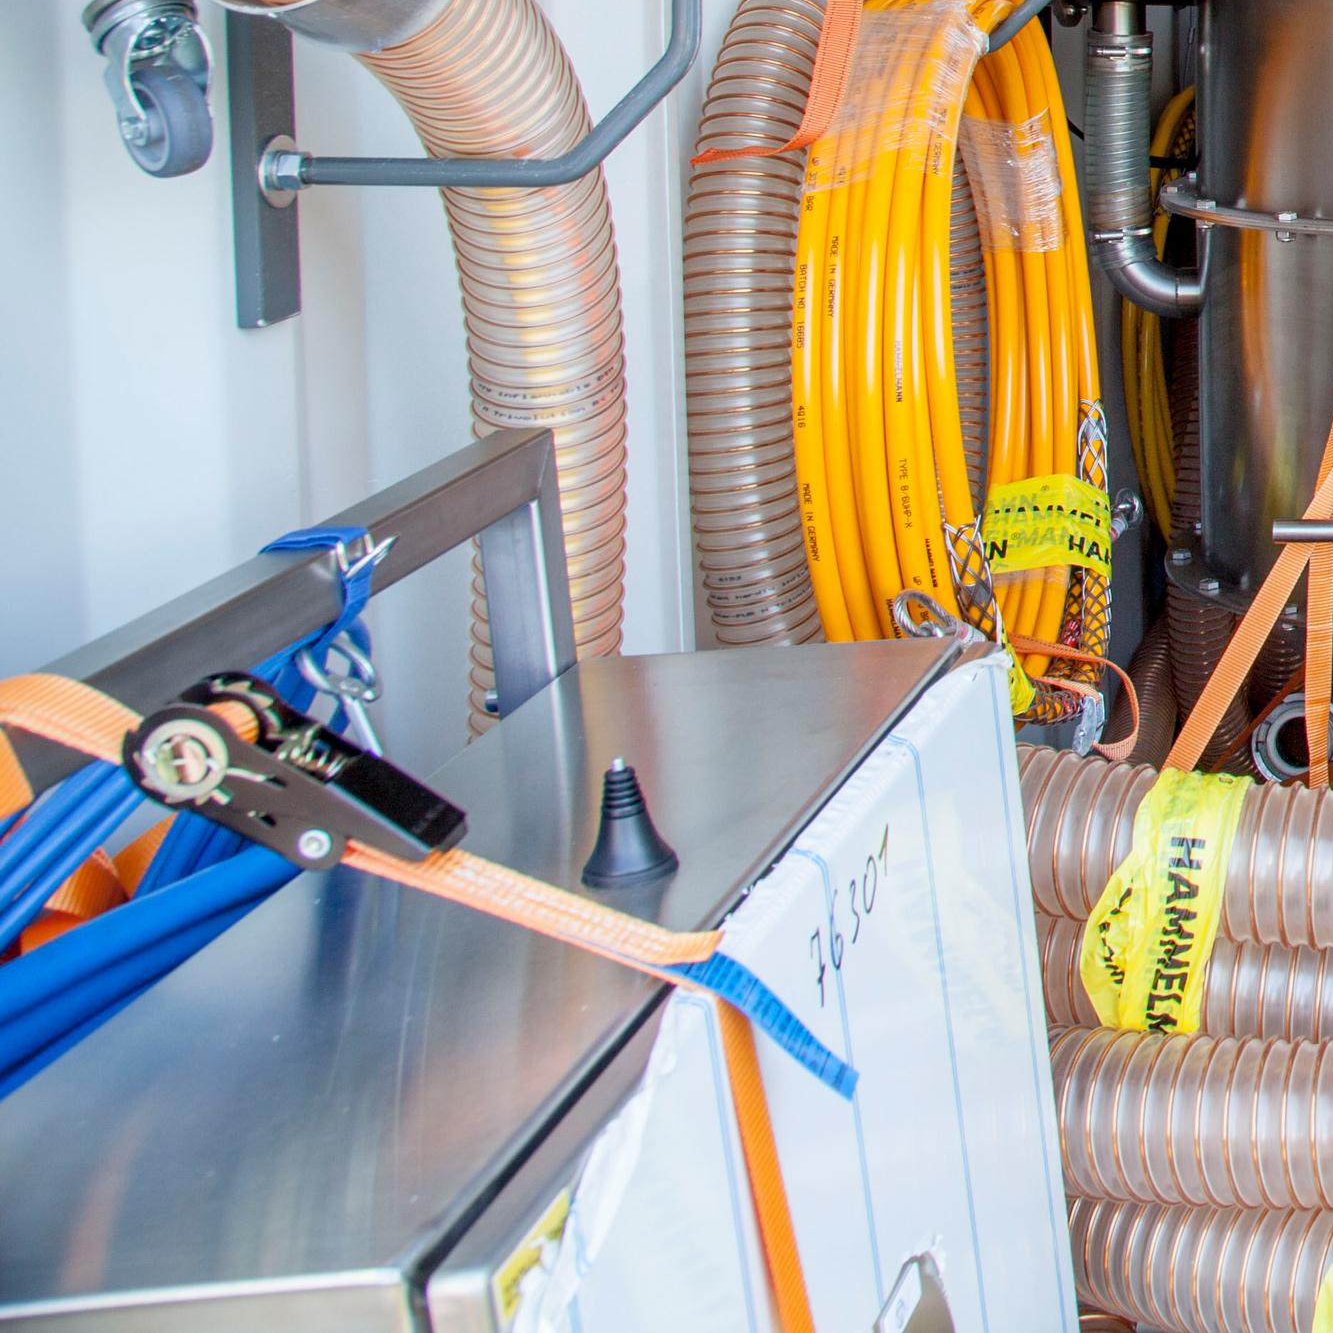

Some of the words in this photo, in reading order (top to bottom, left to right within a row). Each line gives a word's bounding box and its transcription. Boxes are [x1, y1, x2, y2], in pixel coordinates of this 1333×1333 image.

[830, 235, 840, 258] MADE
[899, 457, 909, 480] TYPE
[802, 483, 812, 506] MADE
[808, 525, 820, 563] GERMANY
